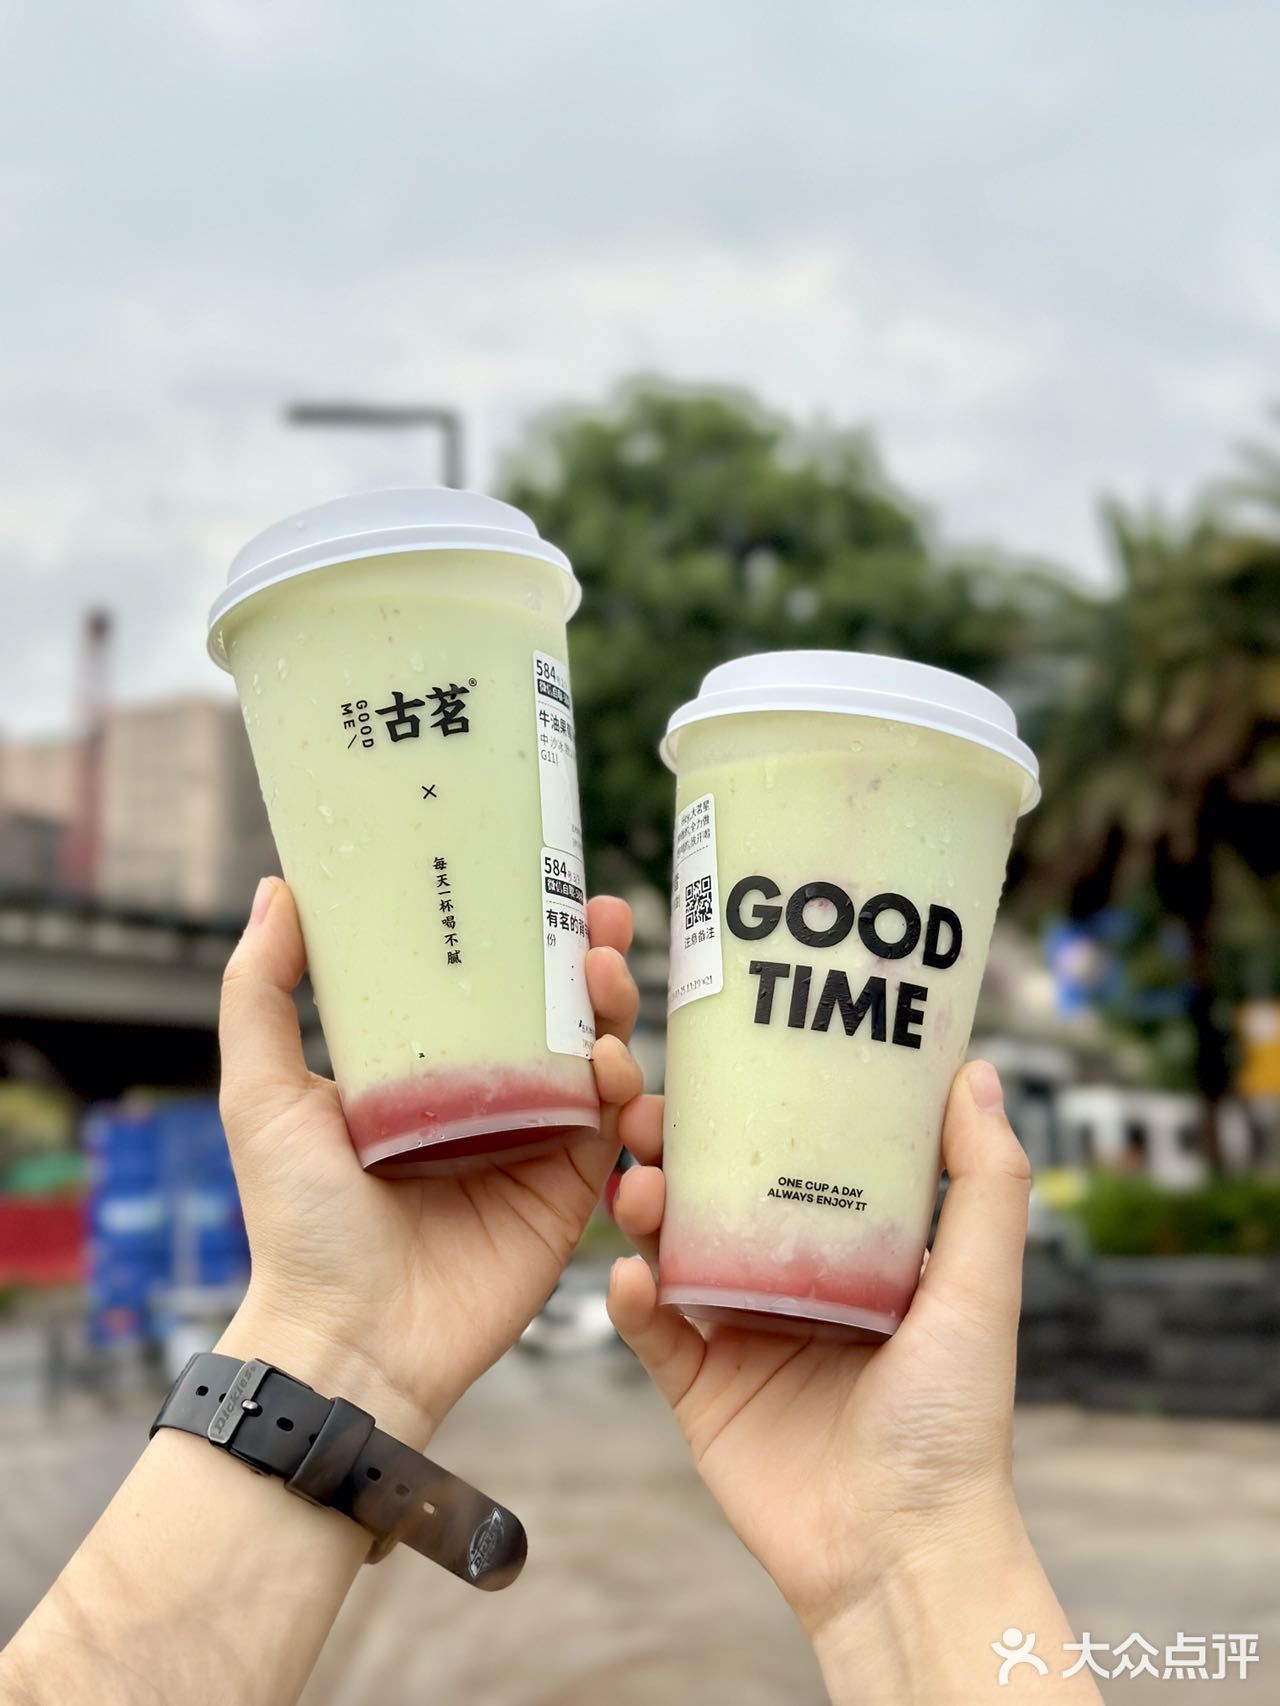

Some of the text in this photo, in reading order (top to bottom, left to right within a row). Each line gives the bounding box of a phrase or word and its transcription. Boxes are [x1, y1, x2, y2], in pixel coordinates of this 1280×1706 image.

[536, 659, 556, 680] 584
[355, 699, 375, 748] GOOD
[544, 856, 567, 878] 584
[432, 856, 462, 965] 每天一杯喝不腻
[726, 875, 963, 970] GOOD
[749, 960, 929, 1050] TIME
[767, 1188, 867, 1212] ALWAYS ENJOY IT
[778, 1176, 863, 1198] ONE CUP A DAY
